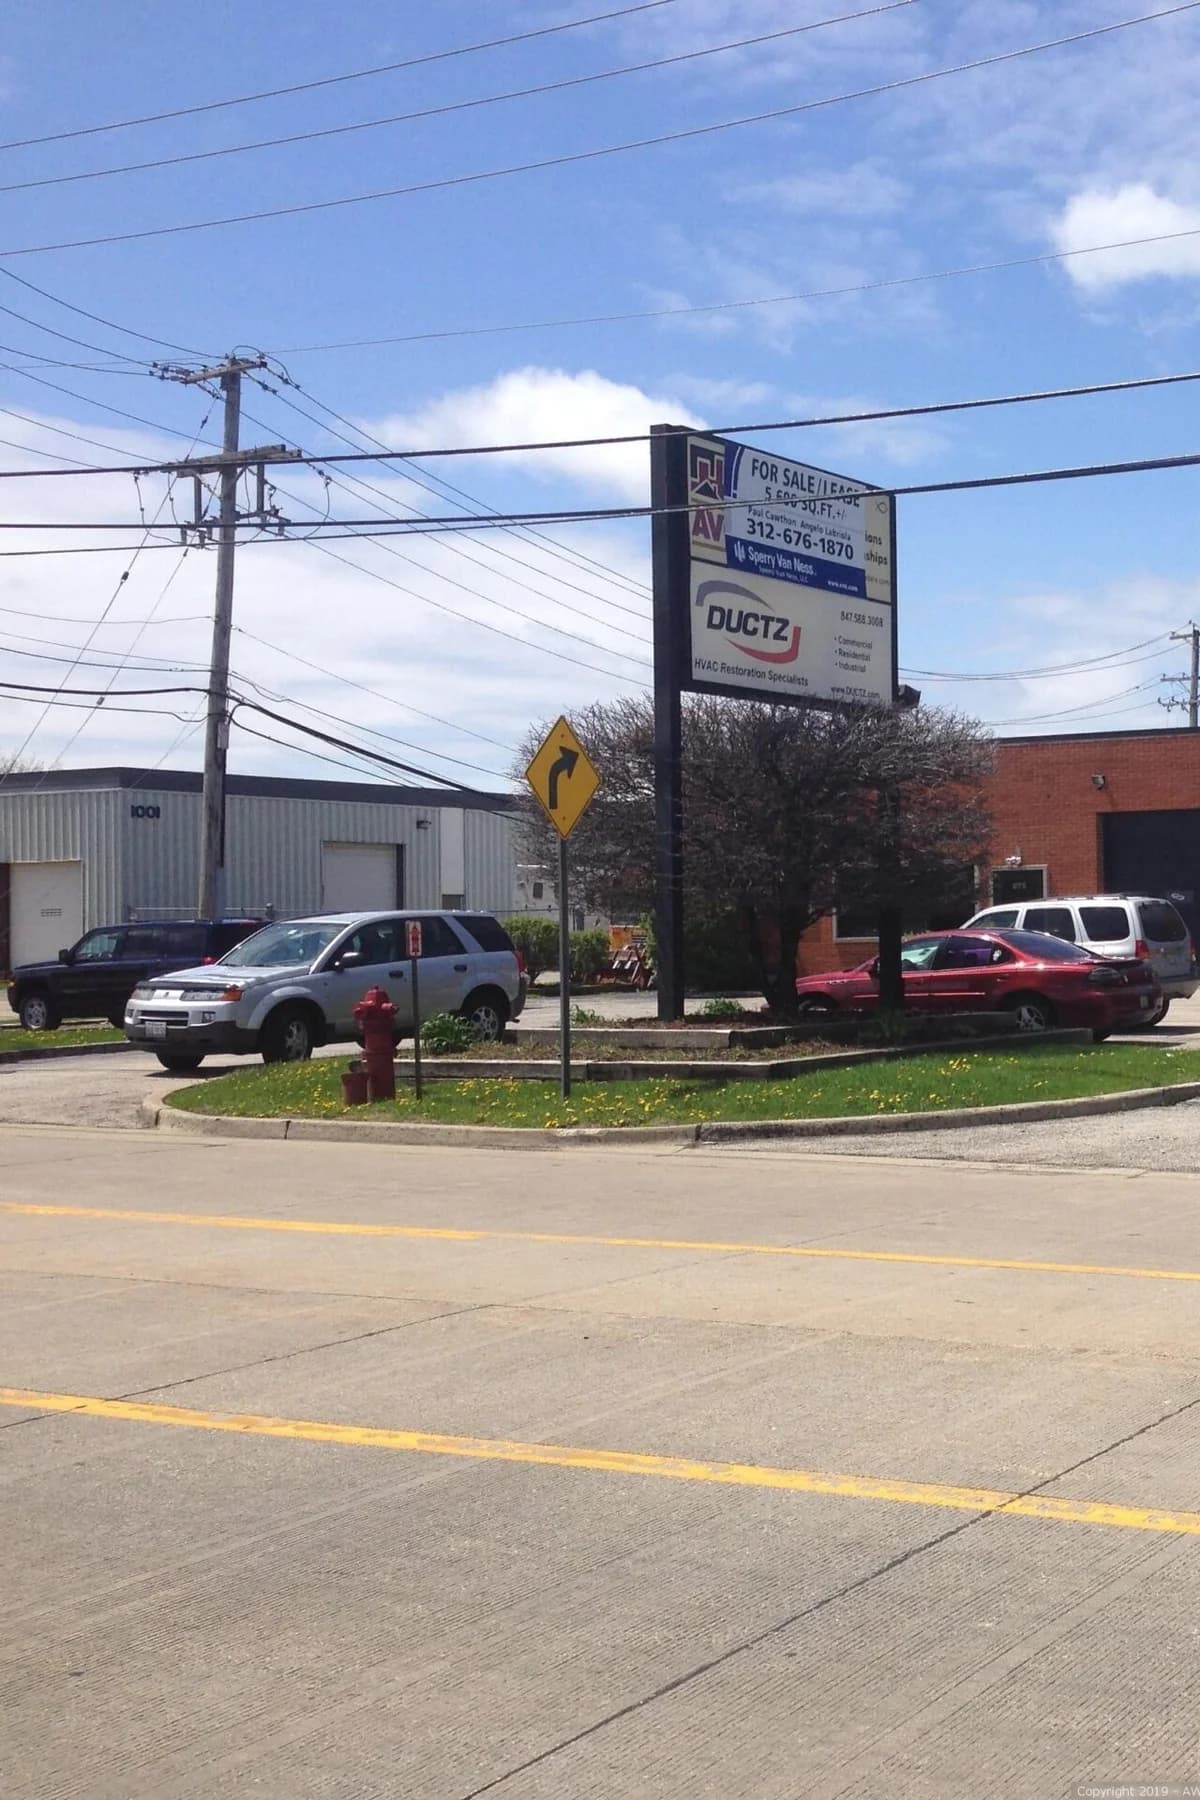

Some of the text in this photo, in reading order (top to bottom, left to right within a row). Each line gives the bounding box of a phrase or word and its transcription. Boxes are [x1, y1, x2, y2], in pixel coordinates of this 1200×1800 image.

[752, 458, 778, 484] FOR
[747, 518, 854, 560] 312-676-1870
[748, 546, 776, 569] Sperry
[776, 553, 792, 570] Van
[707, 604, 790, 642] DUCTZ
[838, 635, 872, 650] Commercial
[838, 648, 871, 662] Residential
[694, 658, 809, 686] HVAC Restoration Specialists
[838, 661, 866, 673] Industrial
